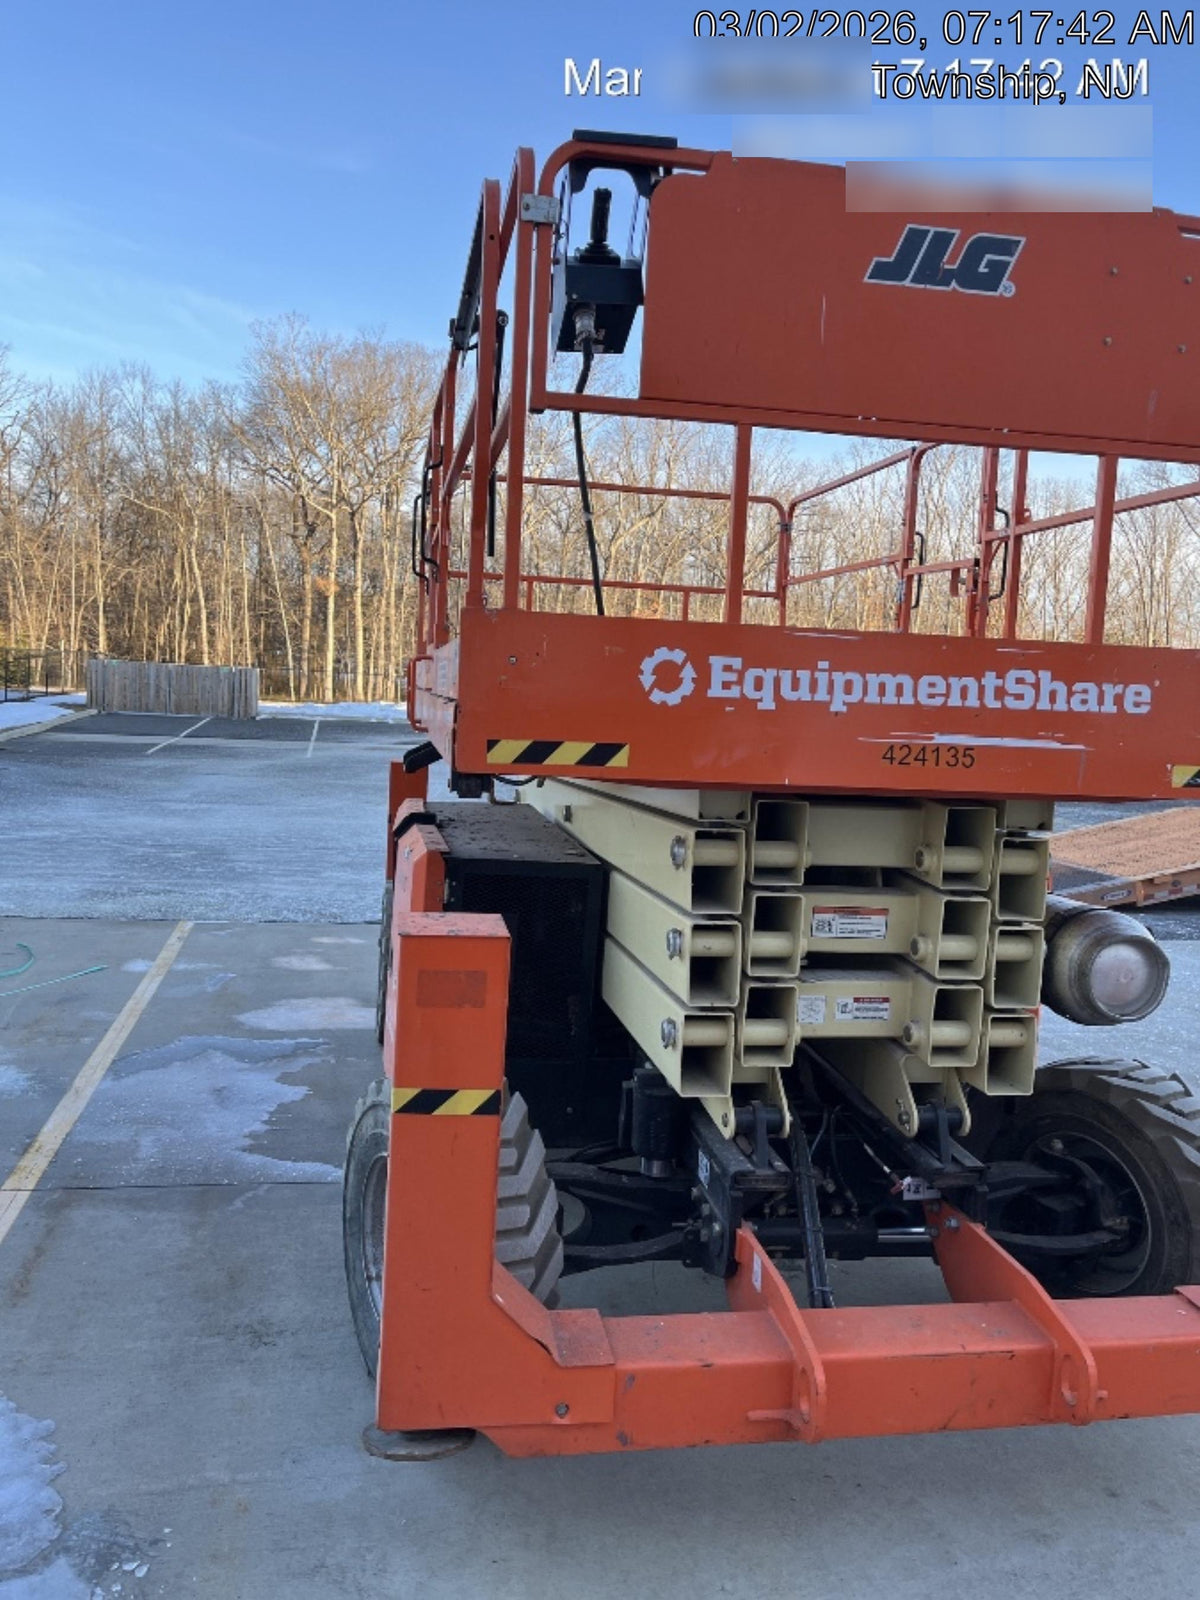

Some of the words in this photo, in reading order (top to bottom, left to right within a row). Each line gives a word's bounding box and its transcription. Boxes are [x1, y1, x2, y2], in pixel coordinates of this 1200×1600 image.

[864, 224, 1026, 296] JLG
[707, 655, 1152, 714] EquipmentShare
[881, 744, 976, 769] 424135
